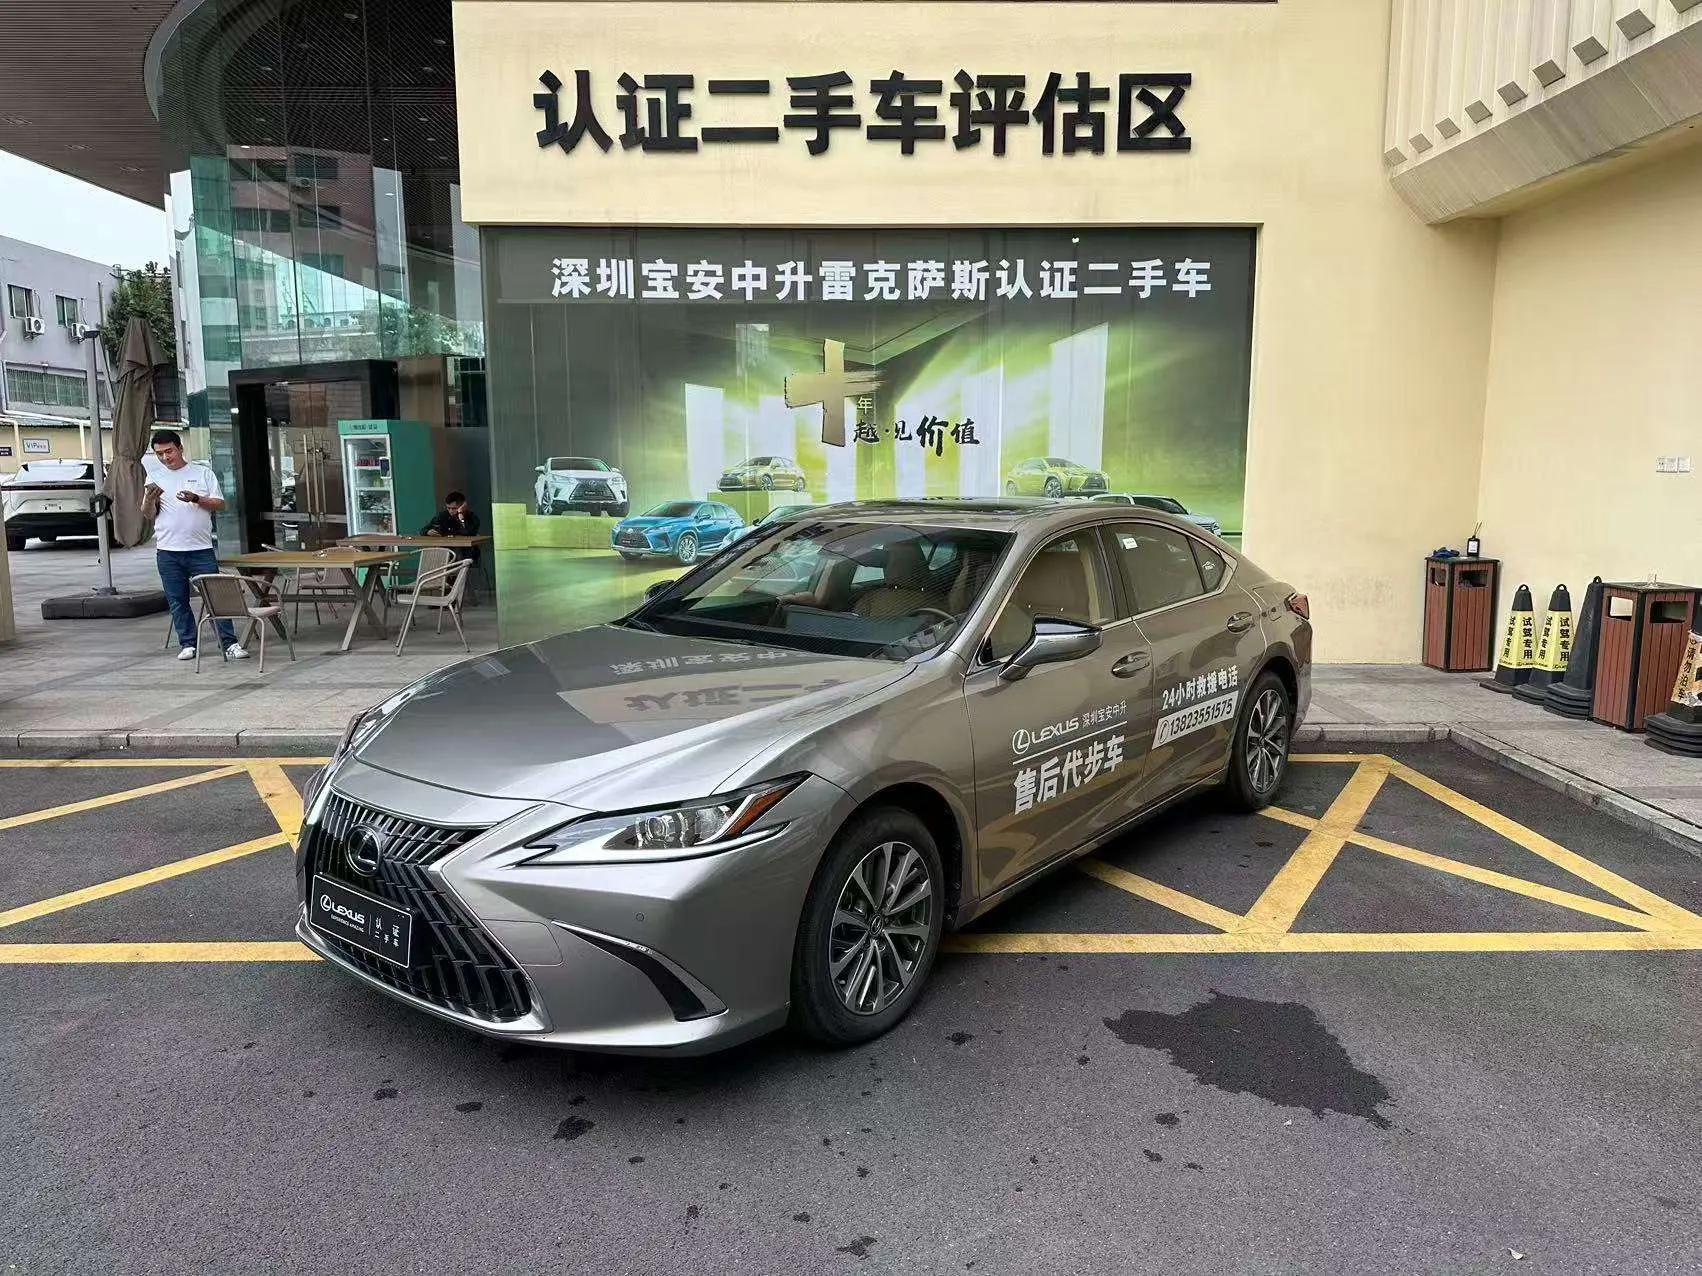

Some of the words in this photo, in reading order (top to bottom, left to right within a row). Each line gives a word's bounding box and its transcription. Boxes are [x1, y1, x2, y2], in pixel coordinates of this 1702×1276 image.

[533, 69, 1193, 155] 认证二手车评估区
[550, 257, 1213, 301] 深圳宝安中升雷克萨斯认证二手车
[1522, 615, 1533, 660] 试驾专用
[1559, 616, 1570, 662] 试驾专用
[1162, 664, 1239, 711] 24小时救援电话
[1031, 717, 1080, 744] LEXUS
[1082, 699, 1127, 730] 深圳宝安中升
[1170, 697, 1234, 736] 13823551575
[1013, 734, 1126, 816] 售后代步车
[332, 901, 365, 924] LEXUS
